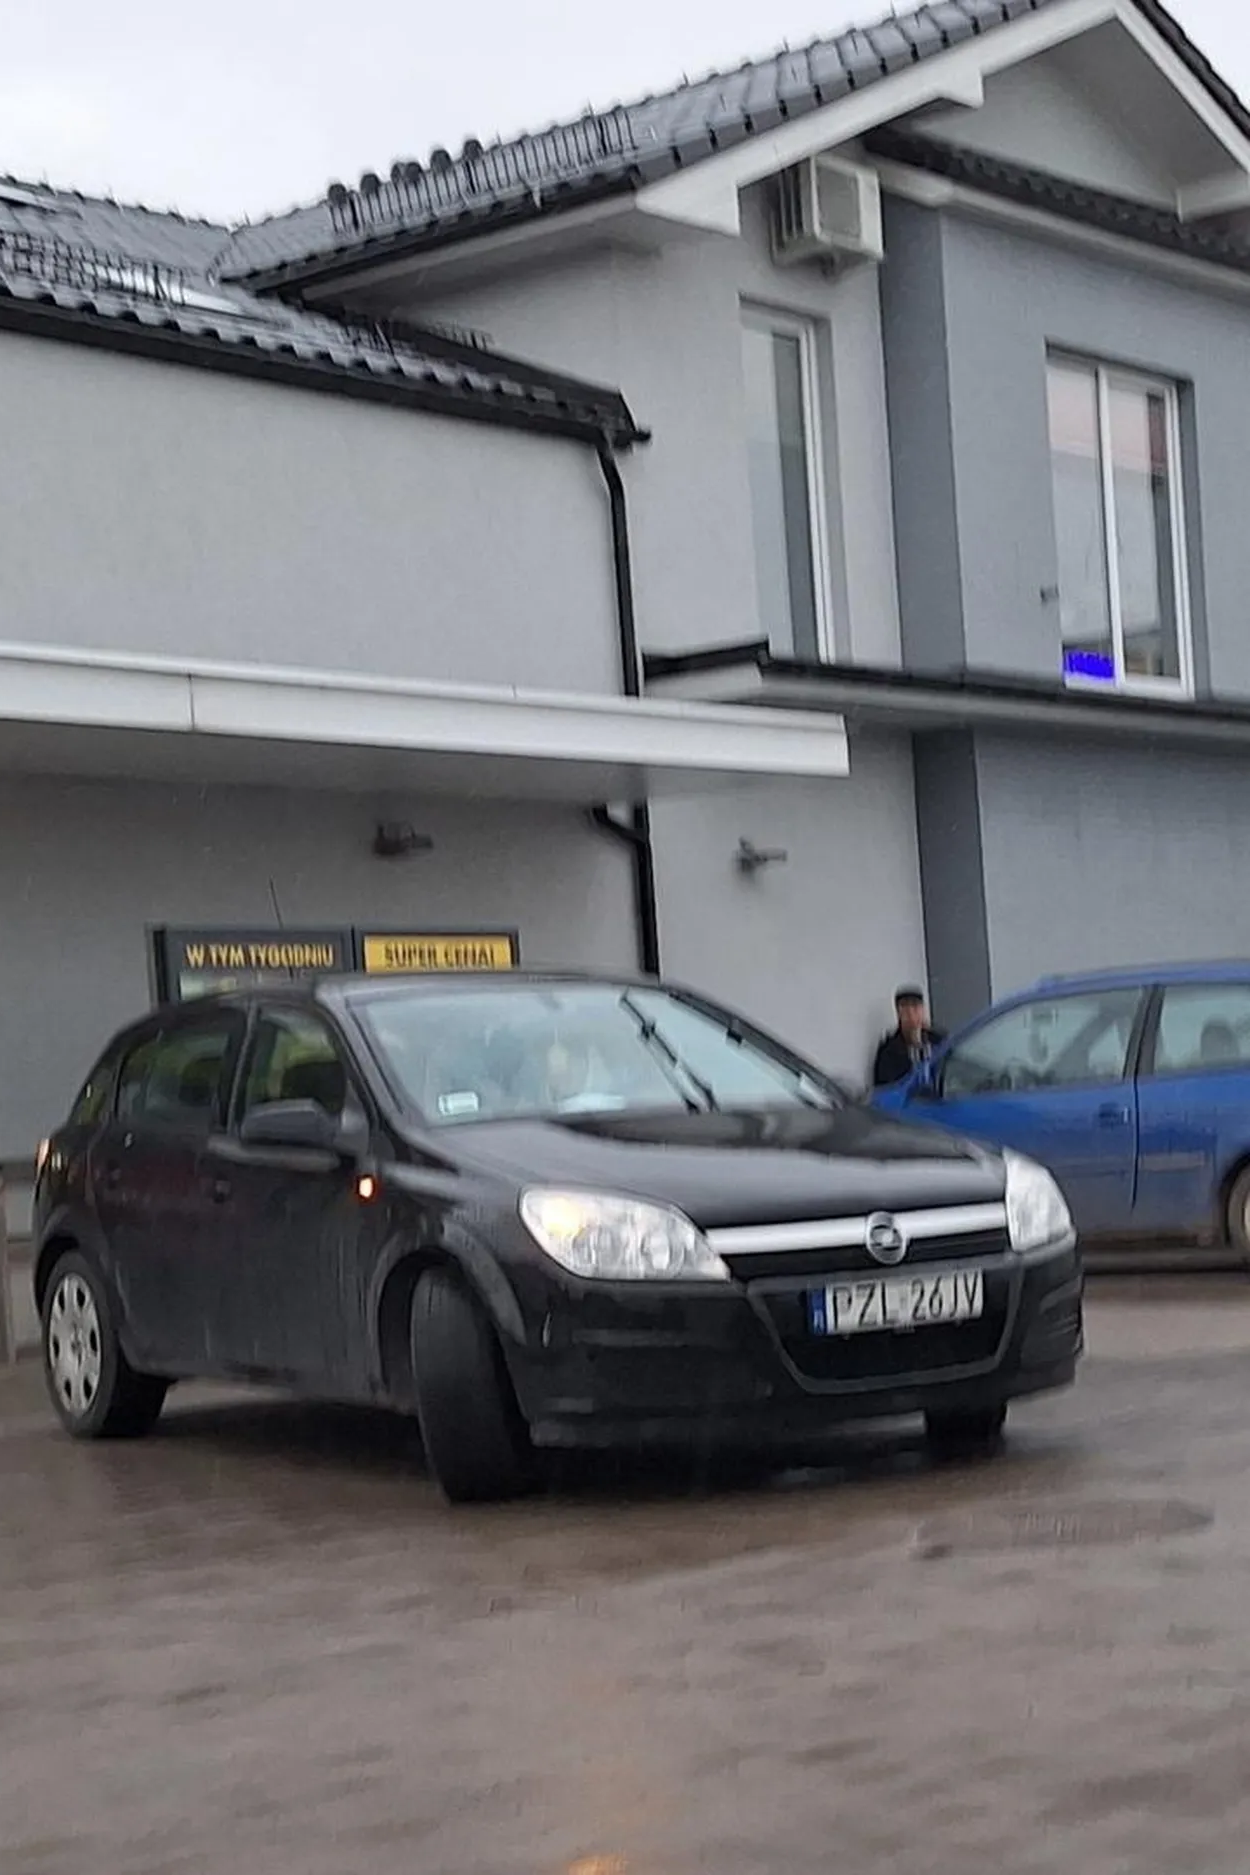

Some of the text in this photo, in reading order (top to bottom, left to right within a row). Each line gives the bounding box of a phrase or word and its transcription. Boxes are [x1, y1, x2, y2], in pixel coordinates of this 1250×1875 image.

[186, 943, 205, 968] W
[208, 943, 247, 968] TYM
[384, 941, 438, 969] SUPER
[833, 1279, 895, 1331] PZL
[910, 1269, 981, 1321] 26JV
